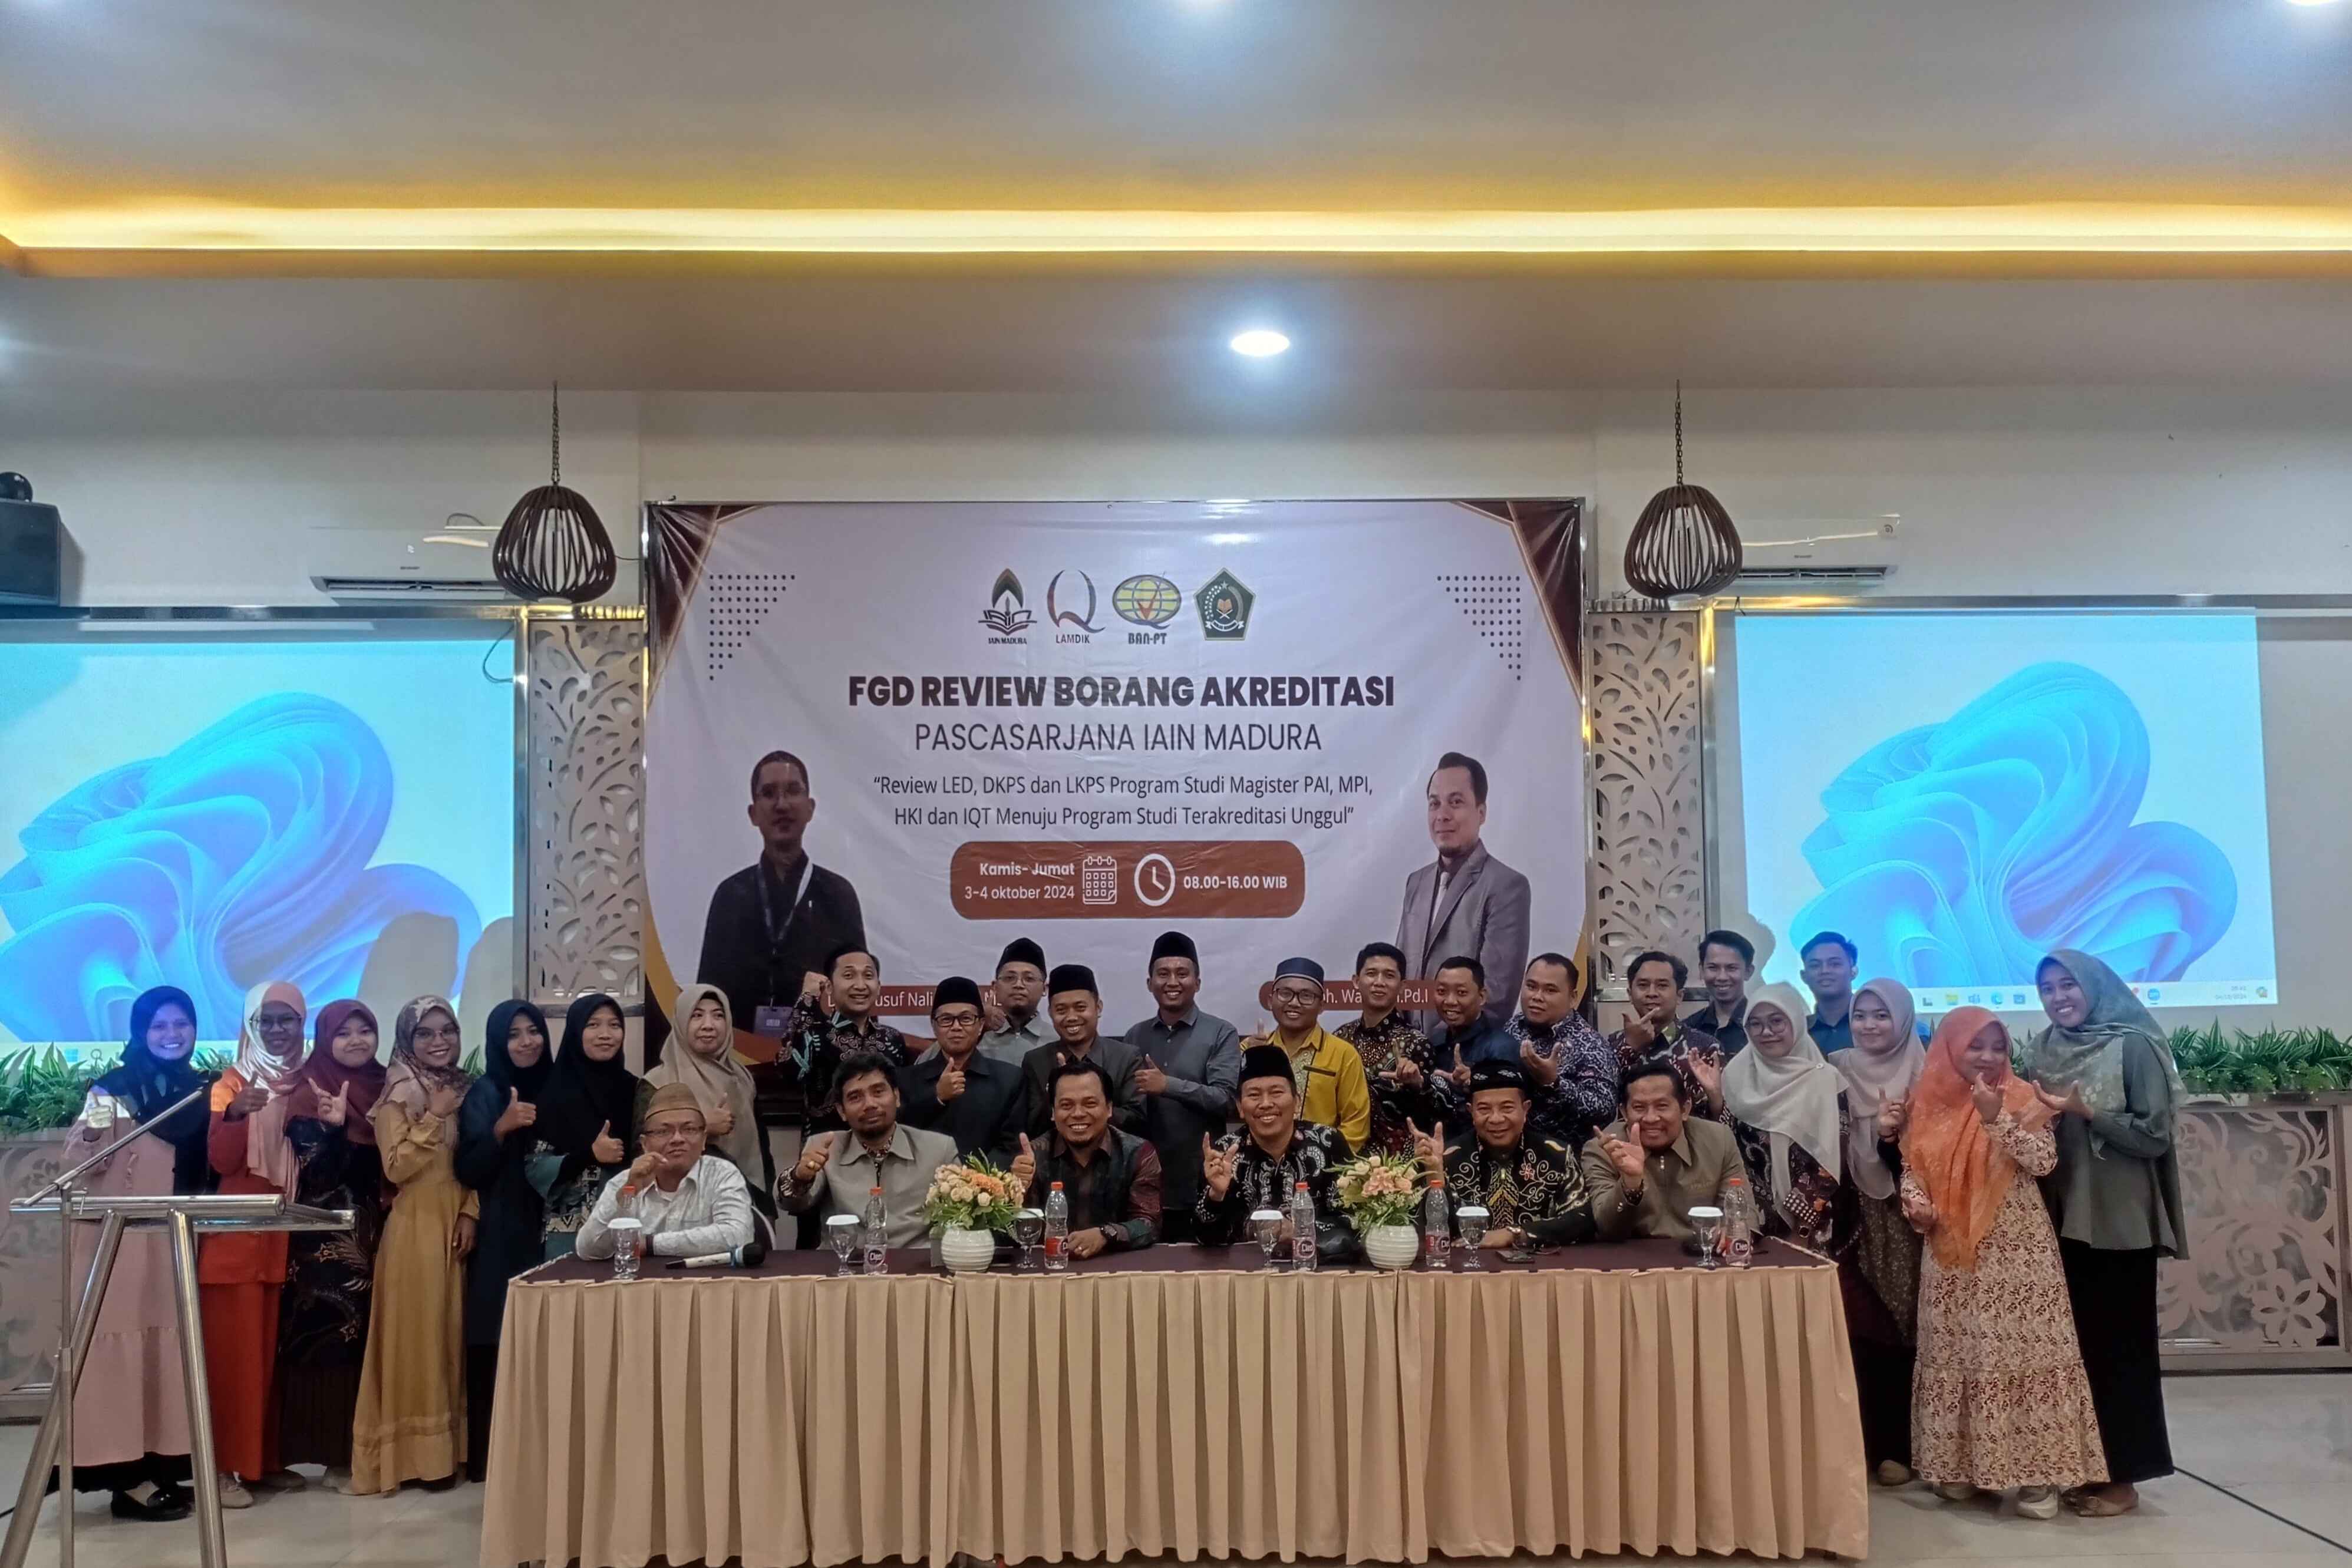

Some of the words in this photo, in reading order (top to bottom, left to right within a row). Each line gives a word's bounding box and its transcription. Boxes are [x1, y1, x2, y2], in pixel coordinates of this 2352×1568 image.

[1055, 634, 1090, 644] LAMDIK
[1128, 633, 1167, 645] BAN-PT
[849, 676, 914, 707] FGD
[921, 676, 1047, 707] REVIEW
[1054, 676, 1194, 707] BORANG
[1200, 676, 1394, 707] AKREDITASI
[915, 724, 1134, 751] PASCASARJANA
[1144, 724, 1195, 750] IAIN
[1205, 724, 1322, 750] MADURA
[943, 777, 977, 796] LED,
[983, 777, 1025, 794] DKPS
[1031, 776, 1061, 794] dan
[1066, 776, 1105, 794] LKPS
[1110, 777, 1179, 798] Program
[1184, 775, 1225, 793] Studi
[1231, 775, 1299, 798] Magister
[1304, 776, 1333, 795] PAI,
[1339, 776, 1373, 795] MPI,
[895, 807, 922, 825] HKI
[928, 807, 958, 825] dan
[964, 807, 991, 828] IQT
[997, 807, 1057, 829] Menuju
[1063, 807, 1132, 829] Program
[1136, 807, 1177, 824] Studi
[1182, 807, 1286, 824] Terakreditasi
[980, 862, 1028, 876] Kamis-
[1032, 863, 1075, 876] Jumat
[1183, 876, 1259, 889] 08.00-16.00
[1262, 876, 1288, 889] WIB
[965, 886, 988, 899] 3-4
[991, 886, 1040, 899] oktober
[1044, 886, 1075, 899] 2024
[875, 991, 905, 1006] usuf
[908, 991, 933, 1006] Nali
[1341, 989, 1363, 1003] Wa
